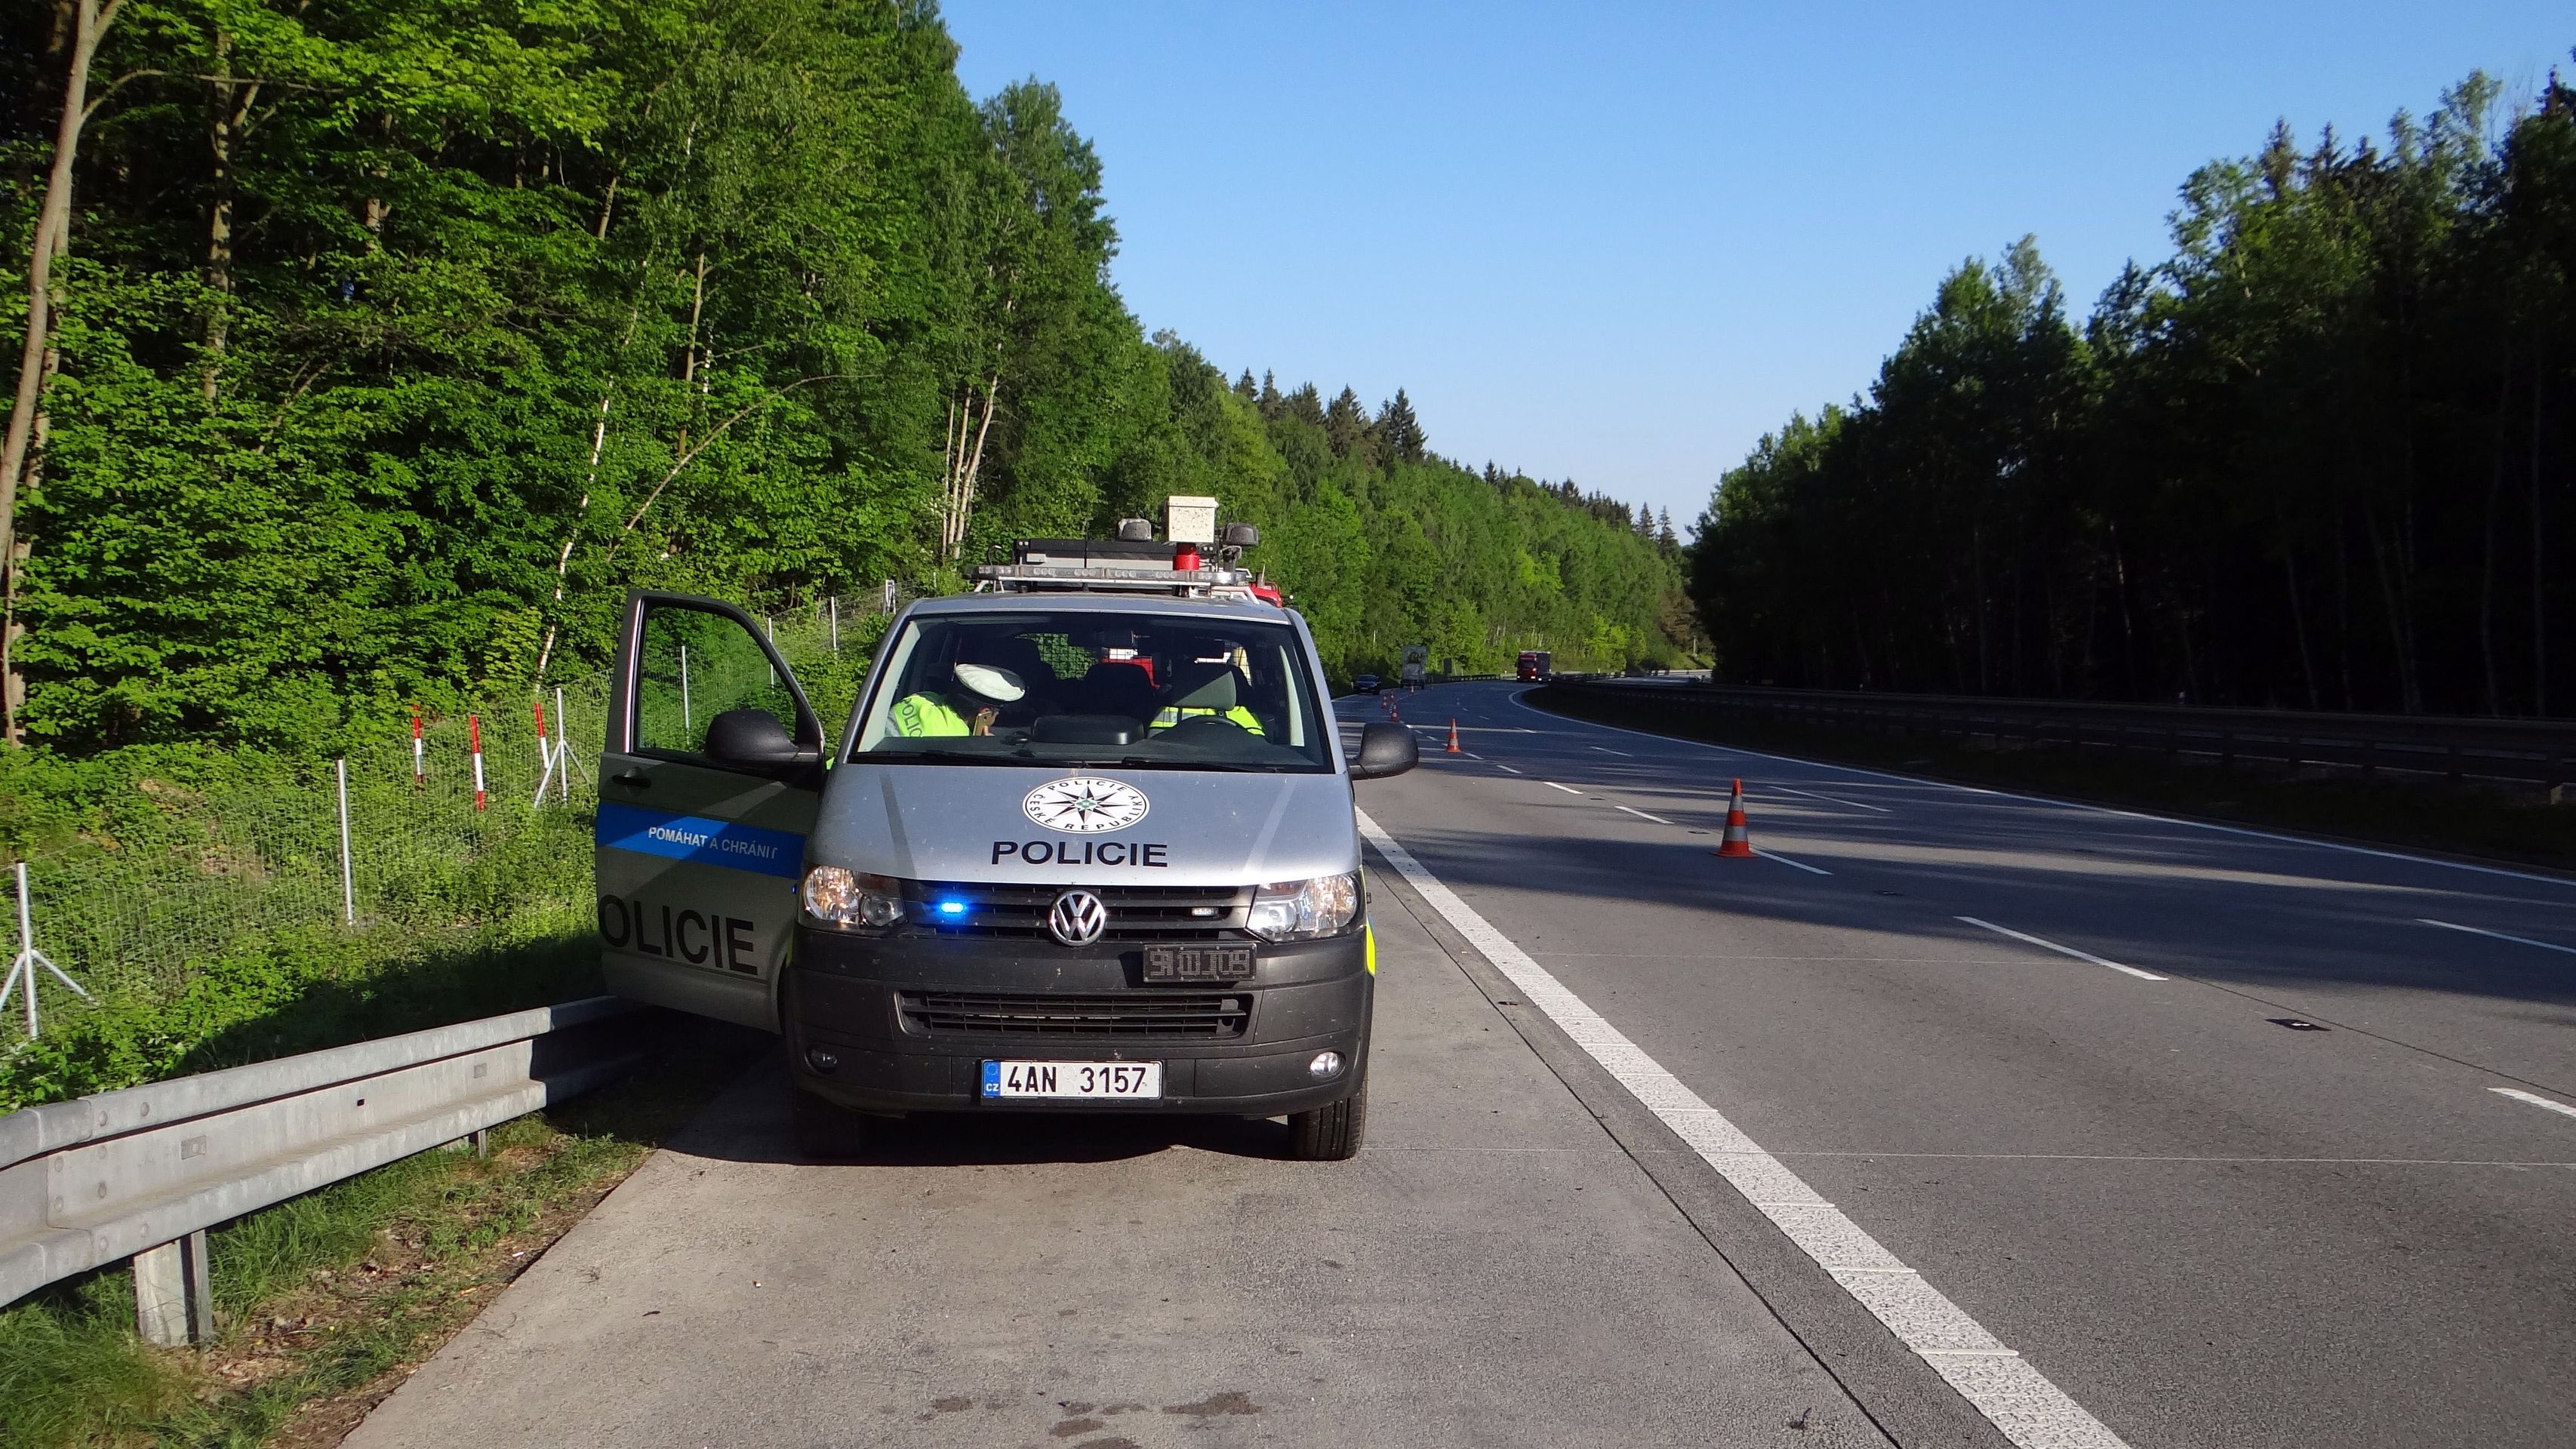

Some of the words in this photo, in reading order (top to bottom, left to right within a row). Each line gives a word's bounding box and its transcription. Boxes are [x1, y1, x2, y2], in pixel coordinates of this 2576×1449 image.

[1047, 780, 1128, 792] POLICIE
[1029, 793, 1056, 824] ČESKÉ
[1064, 795, 1143, 830] REPUBLIKY
[648, 826, 709, 847] POMÁHAT
[709, 838, 719, 850] A
[991, 841, 1168, 868] POLICIE
[598, 894, 758, 976] OLICIE
[986, 1083, 999, 1092] CZ
[1007, 1066, 1057, 1093] 4AN
[1080, 1067, 1146, 1094] 3157
